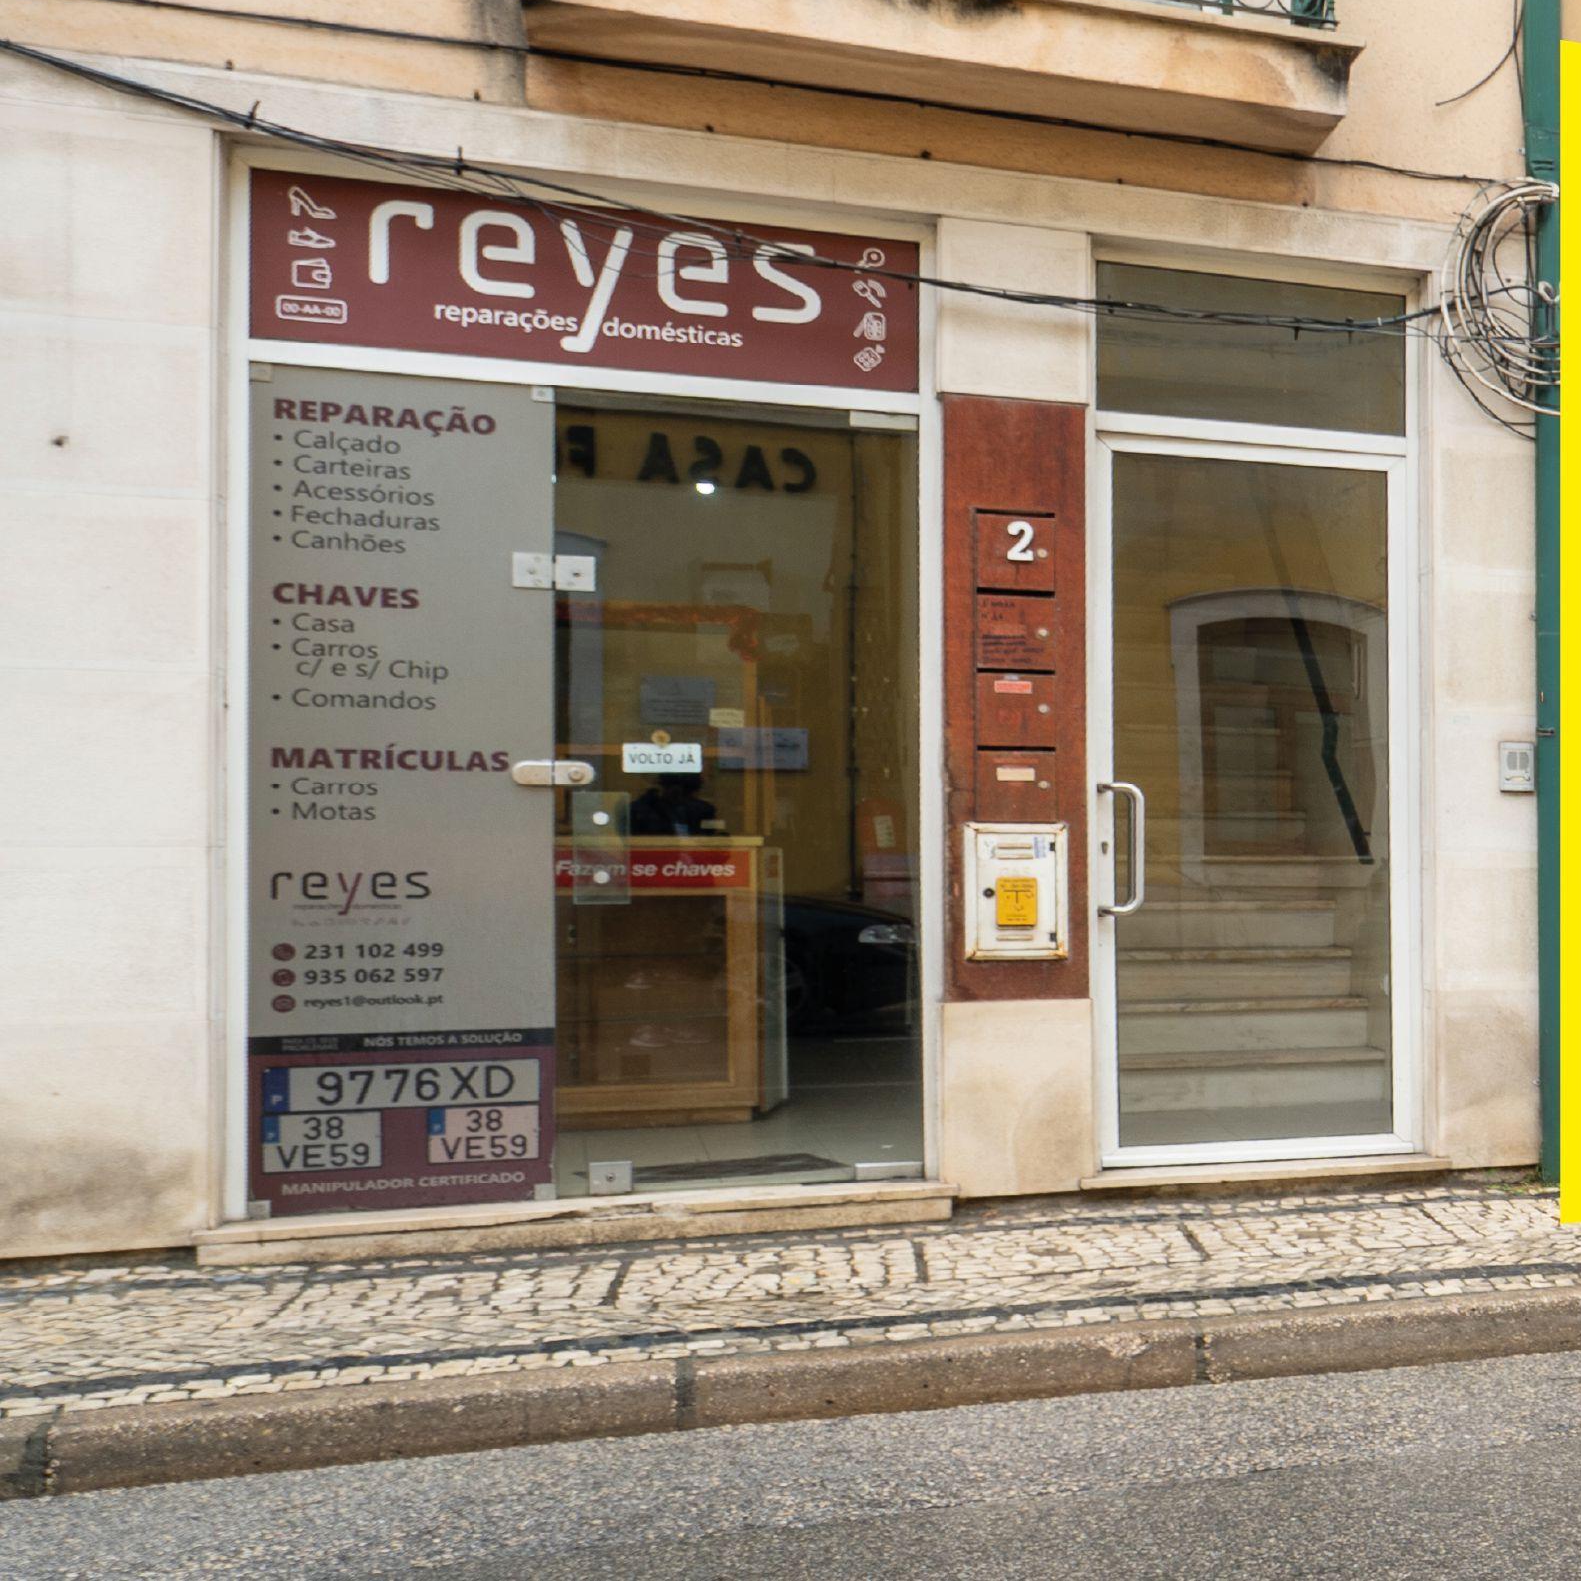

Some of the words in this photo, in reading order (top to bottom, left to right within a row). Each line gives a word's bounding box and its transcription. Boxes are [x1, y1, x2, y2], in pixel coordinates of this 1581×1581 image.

[369, 200, 821, 353] reyes
[434, 303, 579, 333] reparações
[602, 317, 743, 348] domésticas
[273, 398, 497, 437] REPARAÇÃO
[293, 429, 401, 456] Calçado
[293, 454, 411, 481] Carteiras
[292, 480, 435, 507] Acessórios
[291, 505, 440, 531] Fechaduras
[291, 529, 406, 554] Canhões
[1007, 521, 1034, 561] 2
[272, 582, 420, 609] CHAVES
[292, 612, 355, 633] Casa
[292, 637, 378, 659] Carros
[331, 662, 346, 677] e
[389, 660, 449, 684] Chip
[292, 688, 436, 711] Comandos
[271, 743, 510, 772] MATRÍCULAS
[628, 753, 672, 765] VOLTO
[291, 777, 378, 796] Carros
[292, 802, 376, 821] Motas
[632, 863, 658, 877] se
[662, 861, 735, 877] chaves
[270, 872, 432, 915] reyes
[304, 944, 344, 959] 231
[355, 944, 395, 958] 102
[403, 943, 444, 957] 499
[304, 970, 346, 984] 935
[354, 969, 395, 983] 062
[404, 968, 444, 982] 597
[397, 1035, 444, 1046] TEMOS
[448, 1035, 457, 1044] A
[462, 1032, 523, 1044] SOLUÇÃO
[303, 1116, 343, 1140] 38
[466, 1109, 503, 1133] 38
[277, 1142, 370, 1168] VE59
[441, 1135, 527, 1160] VE59
[282, 1178, 415, 1196] MANIPULADOR
[418, 1171, 525, 1189] CERTIFICADO
